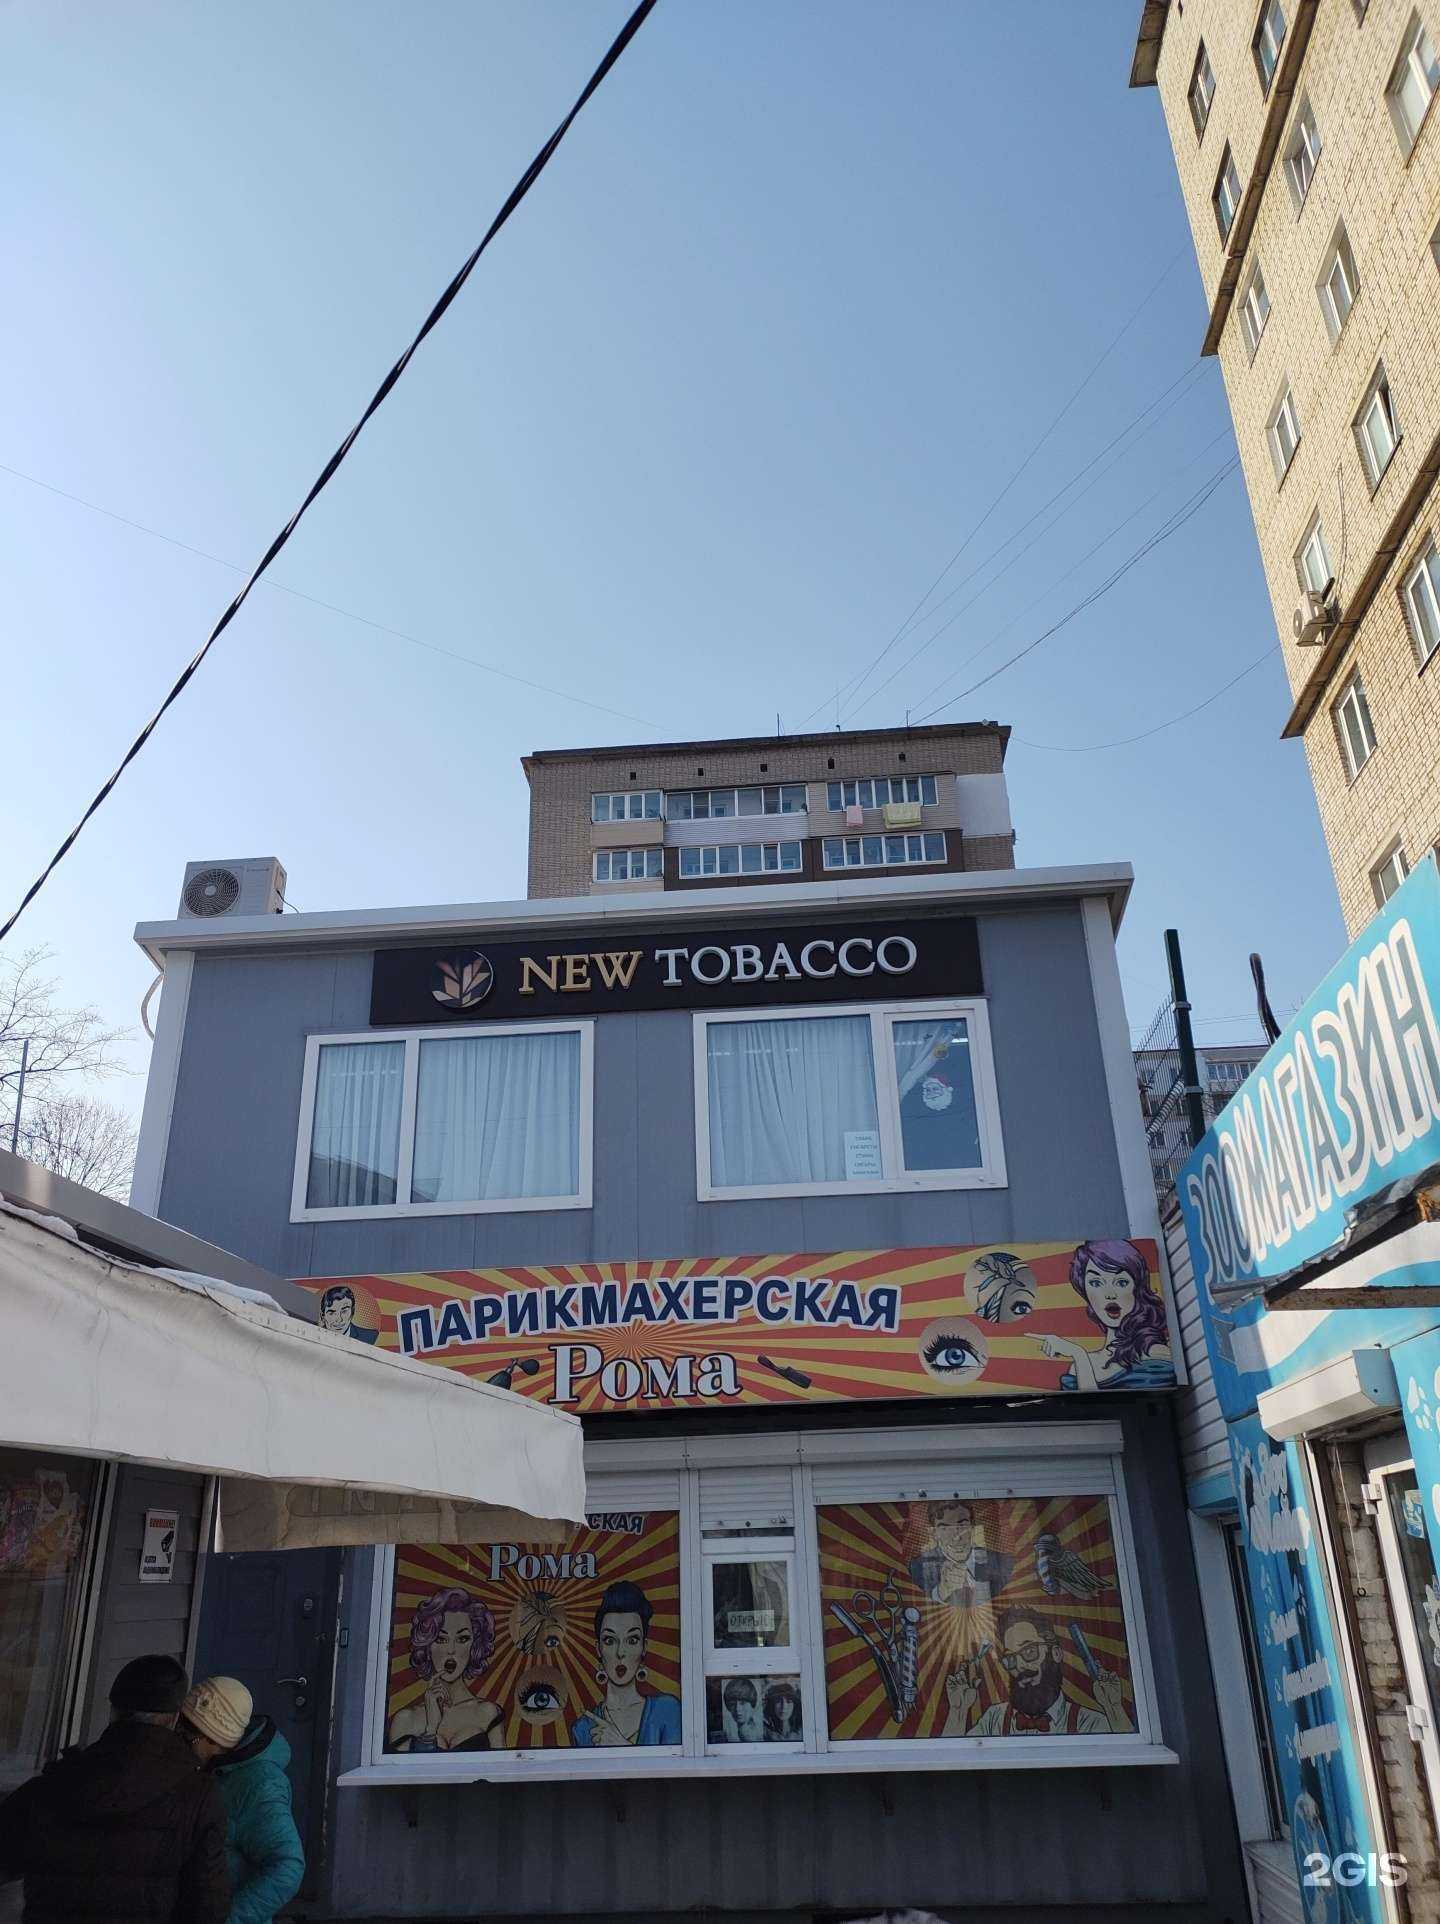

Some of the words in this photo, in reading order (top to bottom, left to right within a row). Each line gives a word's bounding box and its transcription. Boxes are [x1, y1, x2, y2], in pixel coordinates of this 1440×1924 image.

[518, 951, 644, 995] NEW
[655, 935, 918, 987] TOBACCO
[1187, 918, 1440, 1304] ЗООМАГАЗИН
[398, 1277, 902, 1355] ПАРИКМАХЕРСКАЯ
[547, 1342, 741, 1405] Рома
[584, 1513, 645, 1536] СКАЯ
[486, 1543, 598, 1584] Рома
